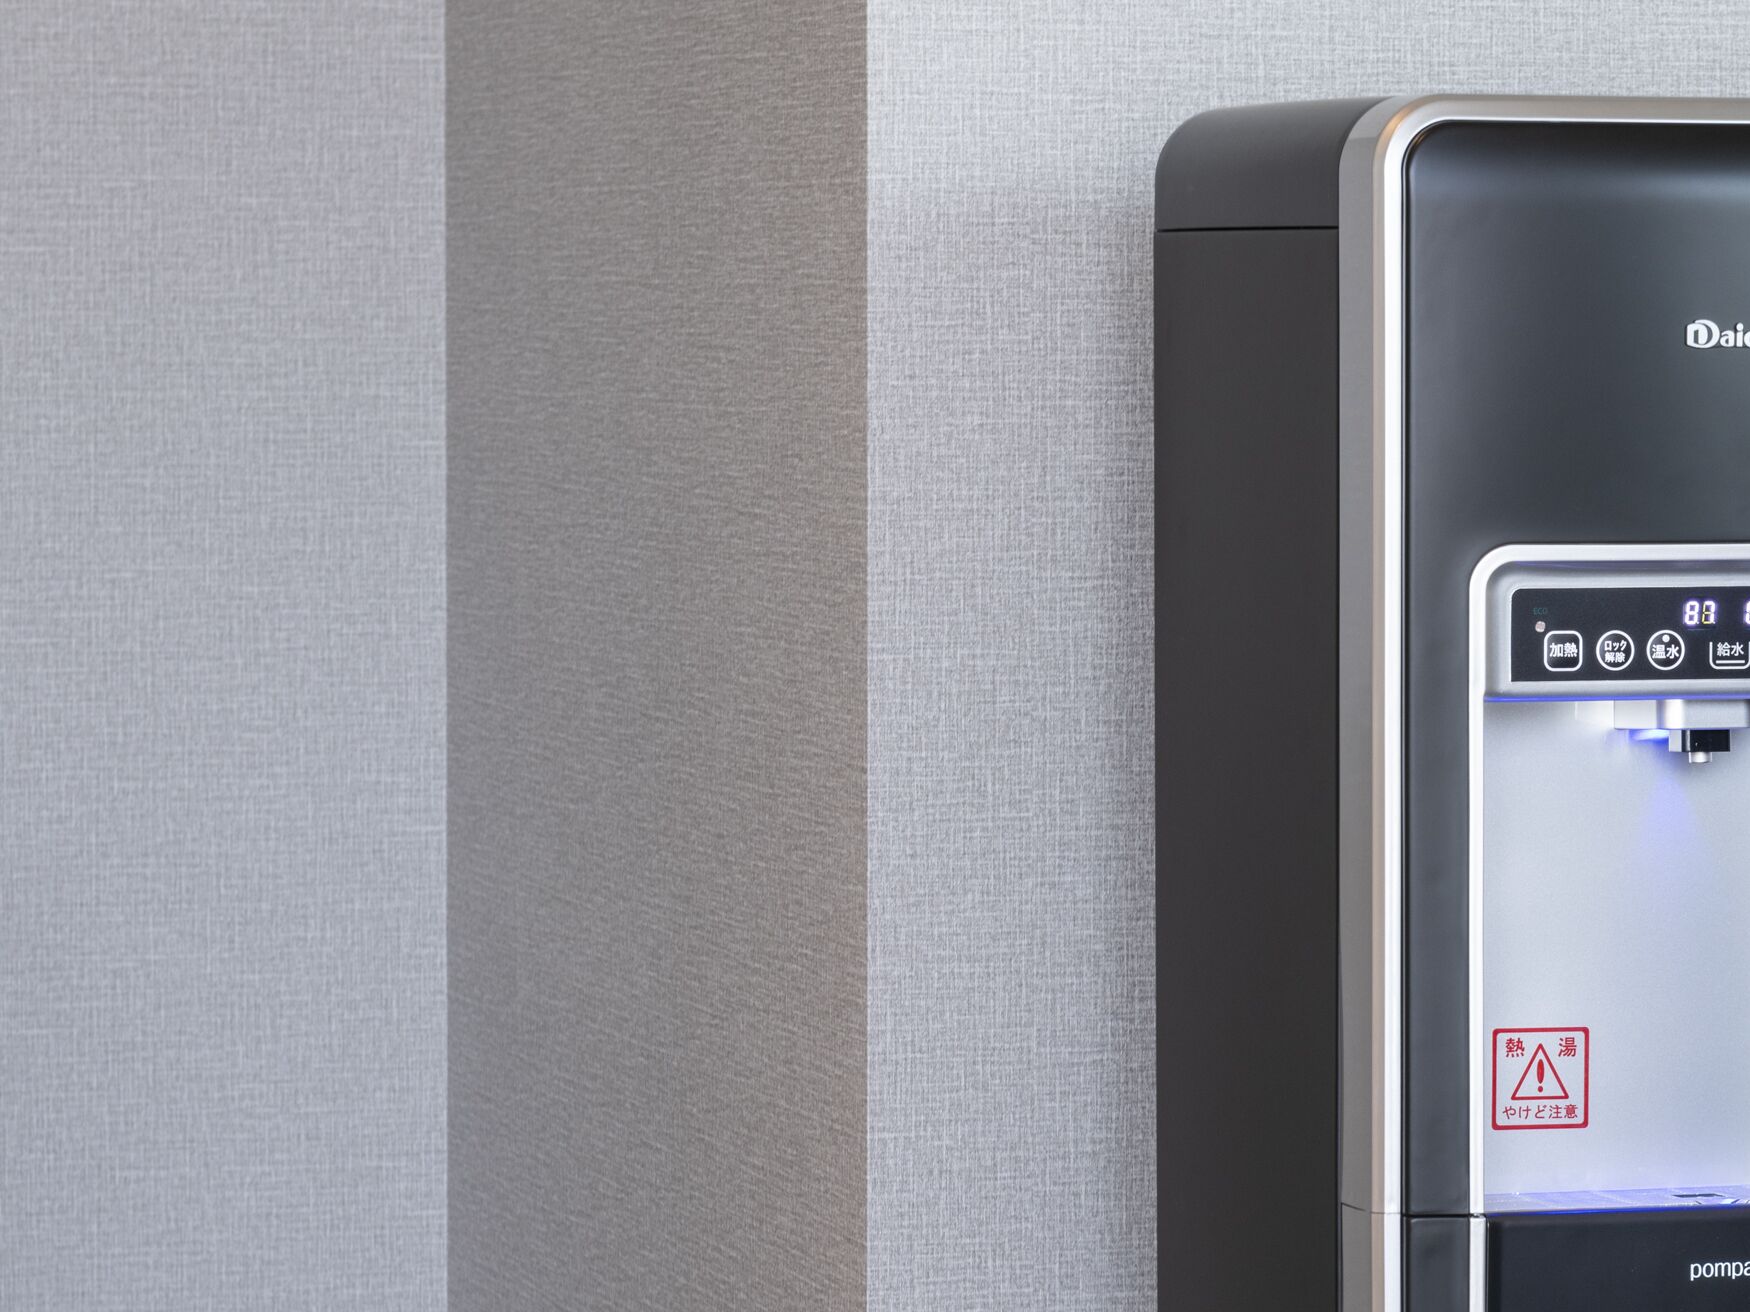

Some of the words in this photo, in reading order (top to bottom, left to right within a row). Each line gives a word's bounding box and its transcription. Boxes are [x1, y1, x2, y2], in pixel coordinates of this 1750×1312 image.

[1532, 606, 1548, 616] ECO
[1684, 600, 1716, 625] 87
[1549, 642, 1578, 658] 加熱
[1603, 639, 1628, 651] ロック
[1651, 643, 1680, 660] 温水
[1716, 641, 1745, 657] 給水
[1604, 651, 1626, 664] 解除
[1502, 1104, 1579, 1120] やけど注意
